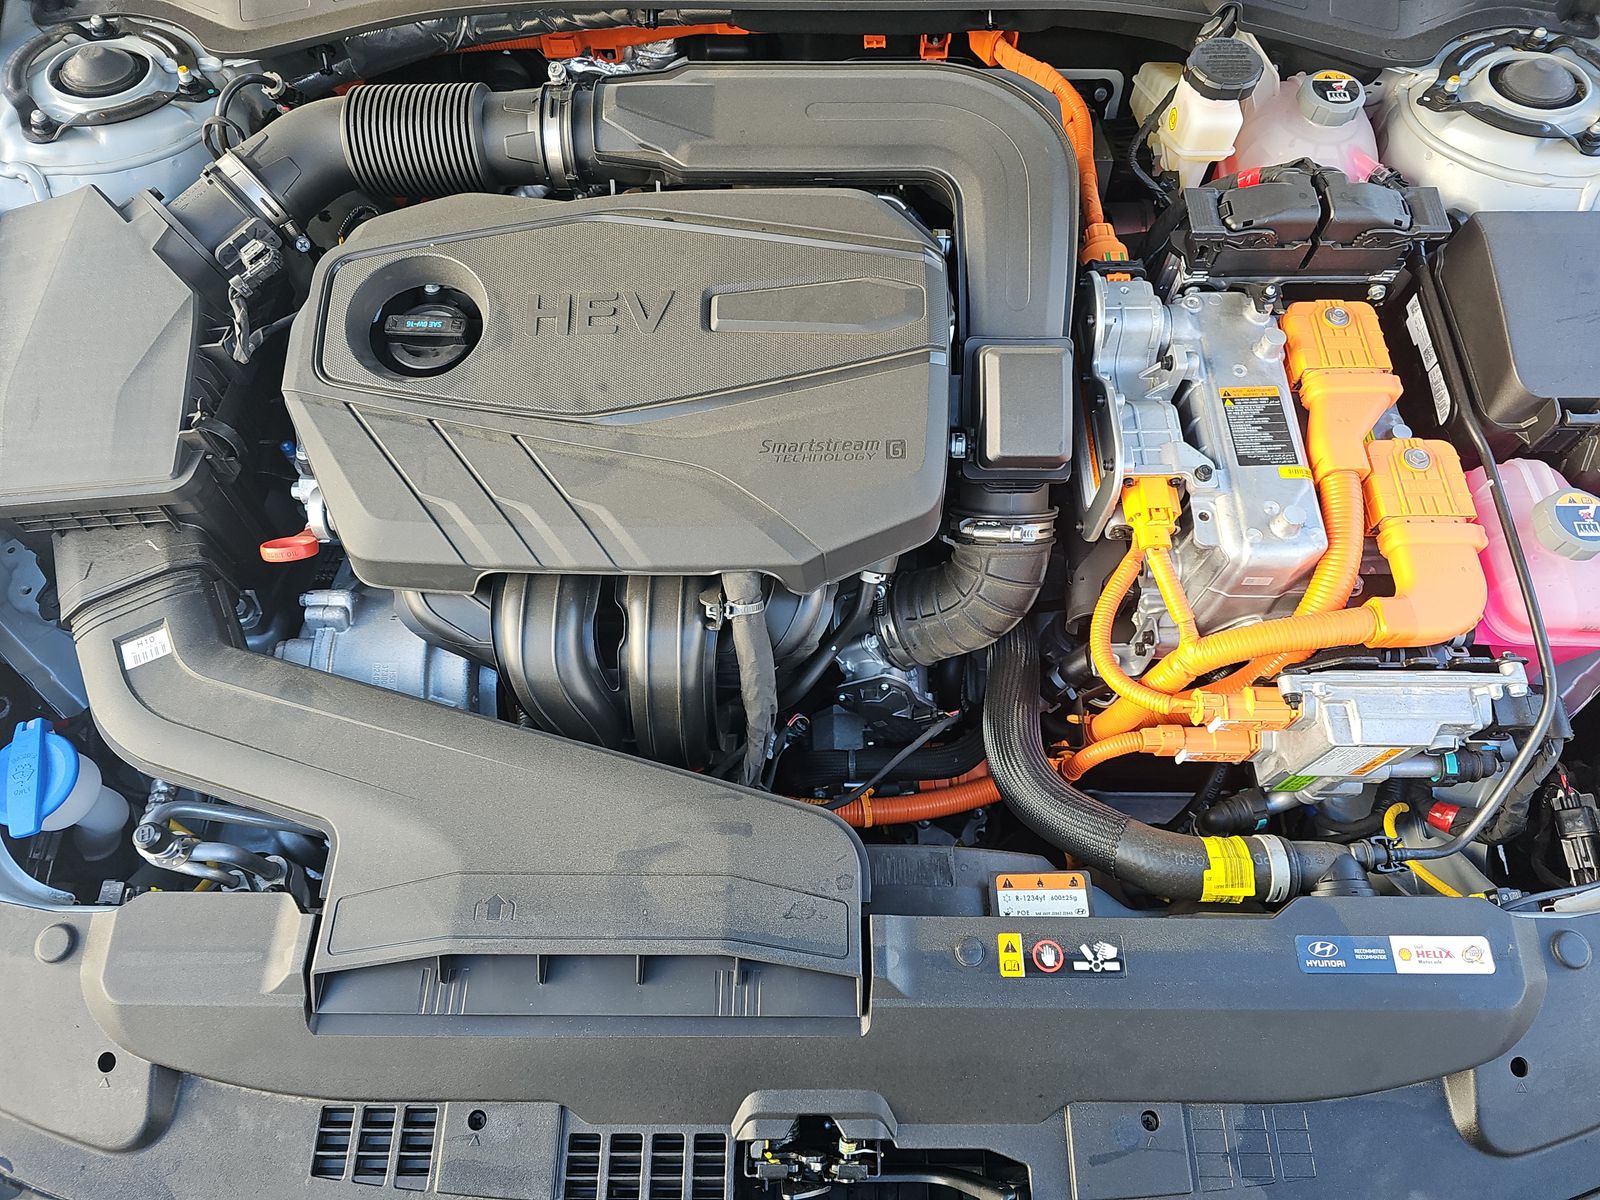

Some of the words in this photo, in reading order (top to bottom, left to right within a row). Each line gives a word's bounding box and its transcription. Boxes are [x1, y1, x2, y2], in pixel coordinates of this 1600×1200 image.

[525, 289, 676, 336] HEV
[428, 320, 443, 328] SAE
[758, 438, 880, 454] Smartstream
[887, 440, 906, 459] G
[774, 452, 877, 463] TECHNOLOGY
[1015, 894, 1046, 902] R-1234yf
[1416, 950, 1453, 959] HELIX
[1306, 959, 1346, 968] HYUNDAI
